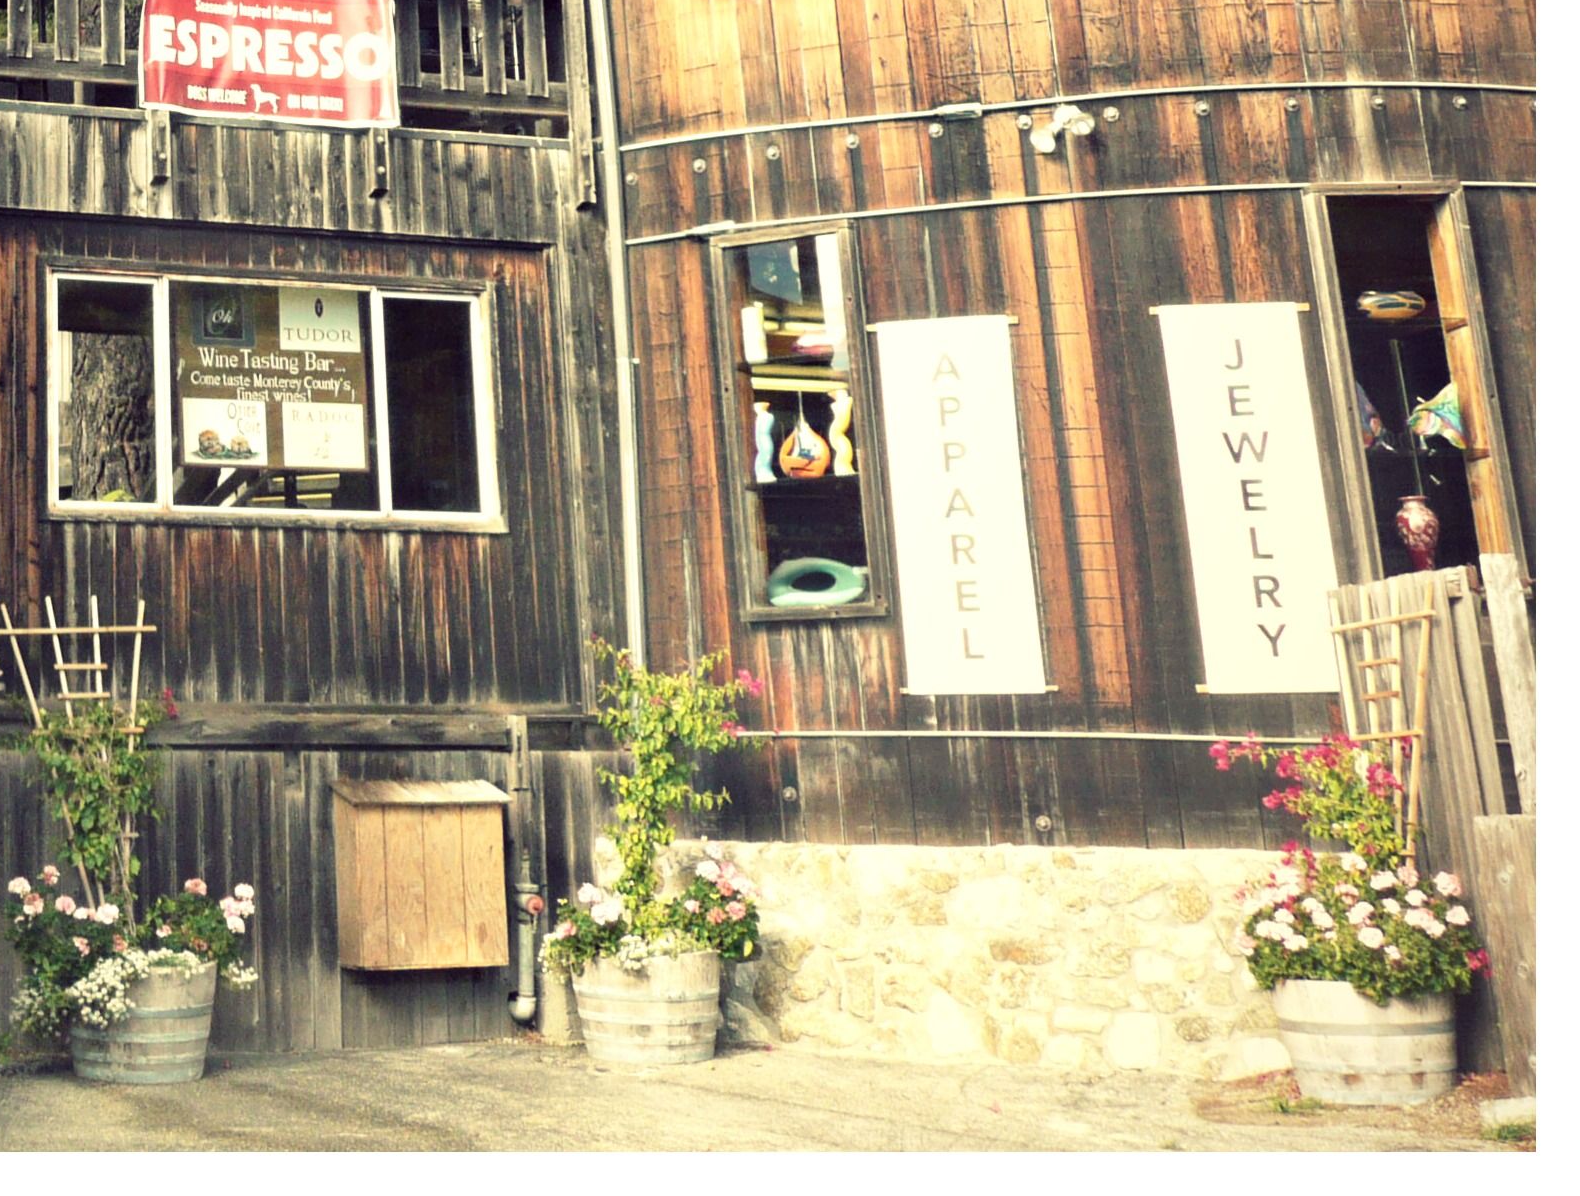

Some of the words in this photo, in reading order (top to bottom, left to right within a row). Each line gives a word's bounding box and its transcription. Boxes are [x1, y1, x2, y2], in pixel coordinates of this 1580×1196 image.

[148, 14, 390, 82] ESPRESSO
[283, 326, 354, 343] TUDOR
[198, 347, 238, 369] Wine
[240, 349, 299, 375] Tasting
[190, 371, 221, 386] Come
[222, 374, 251, 387] taste
[253, 374, 302, 391] Monterey
[237, 387, 269, 402] finest
[932, 352, 985, 661] APPAREL
[1222, 338, 1287, 659] JEWELRY
